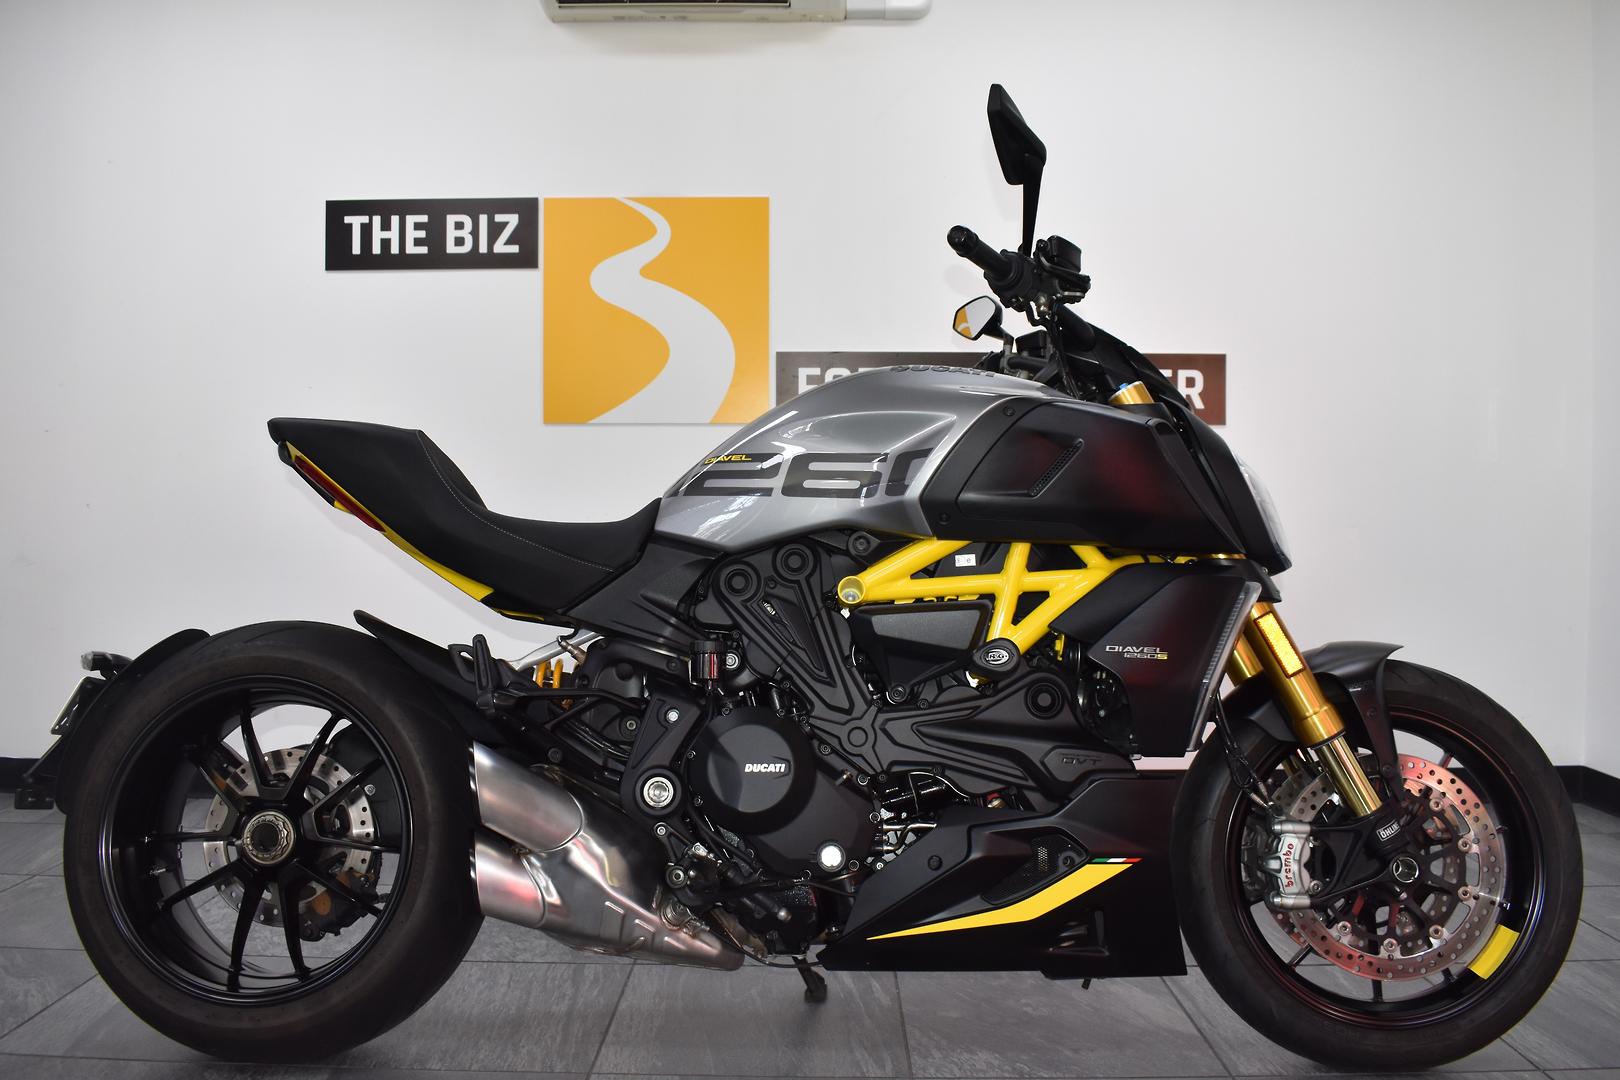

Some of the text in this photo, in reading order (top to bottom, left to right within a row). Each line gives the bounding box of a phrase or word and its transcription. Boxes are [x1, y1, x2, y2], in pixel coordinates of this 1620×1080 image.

[344, 213, 520, 255] THE BIZ
[704, 454, 752, 465] DIAVEL
[1105, 645, 1168, 654] DIAVEL
[1124, 652, 1168, 660] 1260S
[744, 763, 786, 773] DUCATI
[1283, 843, 1295, 888] brembo
